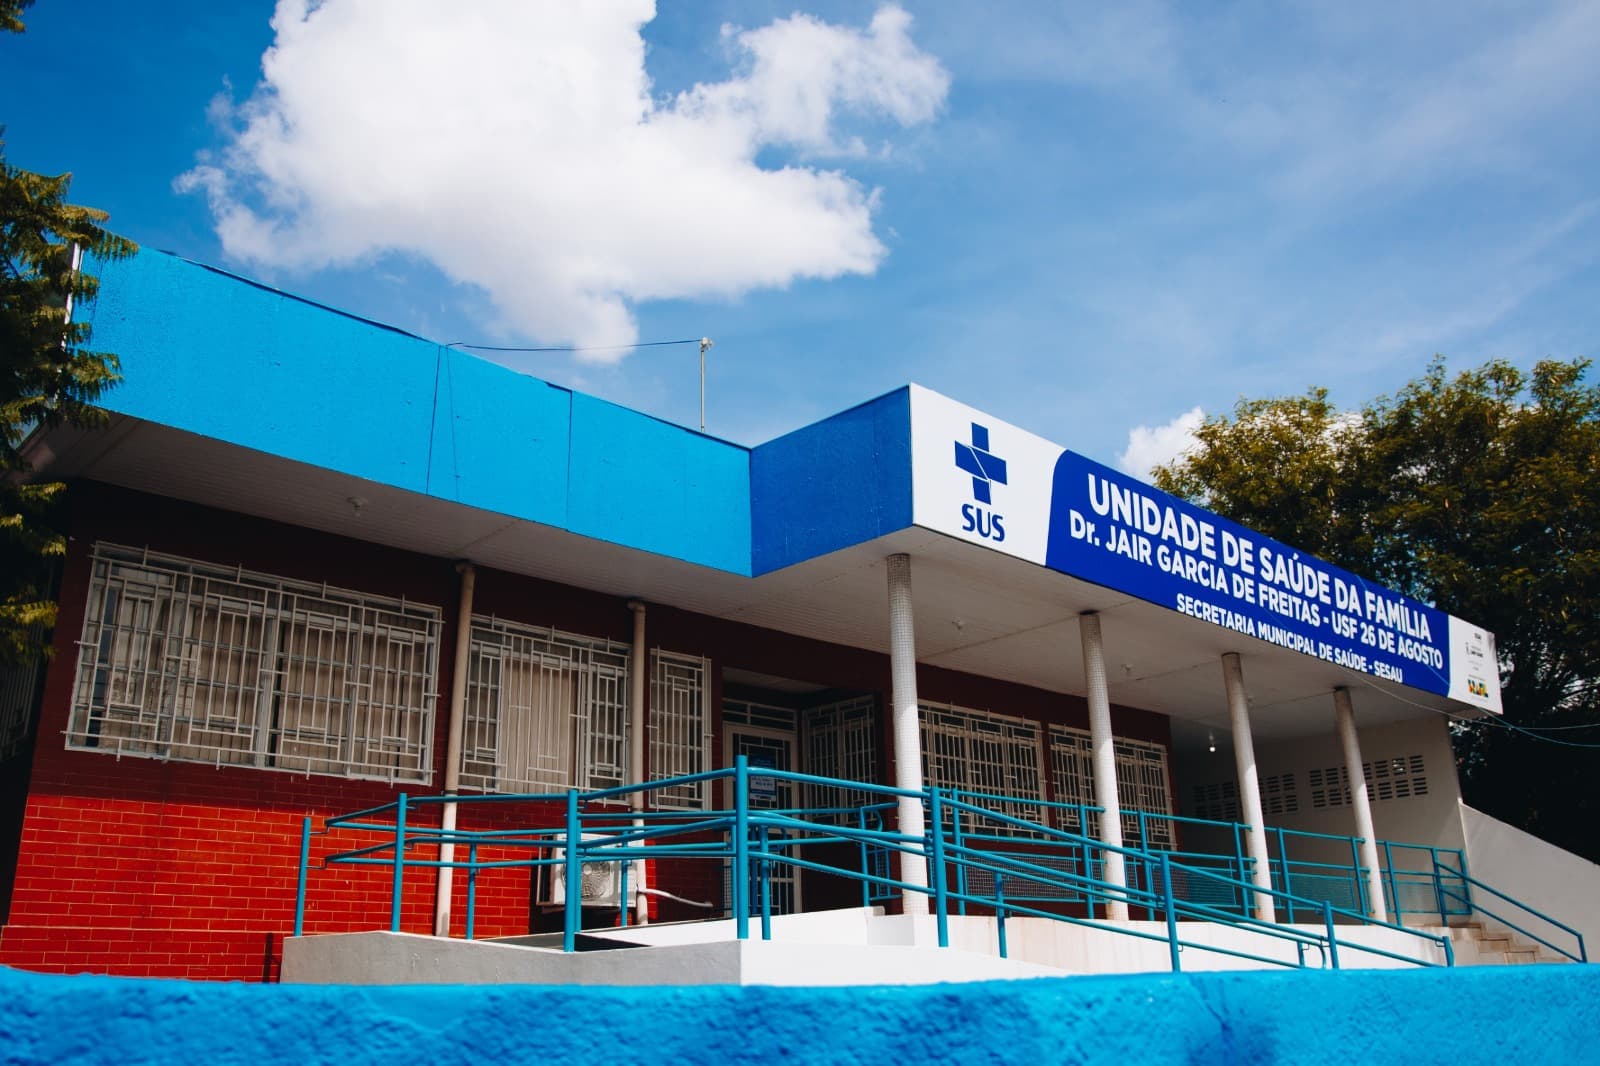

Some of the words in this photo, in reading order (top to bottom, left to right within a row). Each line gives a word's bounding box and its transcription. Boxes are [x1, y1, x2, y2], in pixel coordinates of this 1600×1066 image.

[961, 503, 1005, 542] SUS
[1088, 473, 1217, 560] UNIDADE
[1221, 530, 1255, 576] DE
[1259, 547, 1331, 605] SAÚDE
[1334, 577, 1362, 617] DA
[1365, 590, 1432, 643] FAMÍLIA
[1069, 509, 1100, 546] Dr.
[1105, 525, 1152, 566] JAIR
[1157, 544, 1229, 594] GARCIA
[1232, 572, 1256, 604] DE
[1258, 582, 1320, 628] FREITAS
[1331, 610, 1358, 640] USF
[1360, 621, 1376, 647] 26
[1378, 628, 1396, 654] DE
[1398, 635, 1443, 670] AGOSTO
[1176, 593, 1256, 637] SECRETARIA
[1258, 620, 1317, 656] MUNICIPAL
[1319, 641, 1333, 662] DE
[1334, 647, 1367, 672] SAÚDE
[1373, 660, 1403, 683] SESAU
